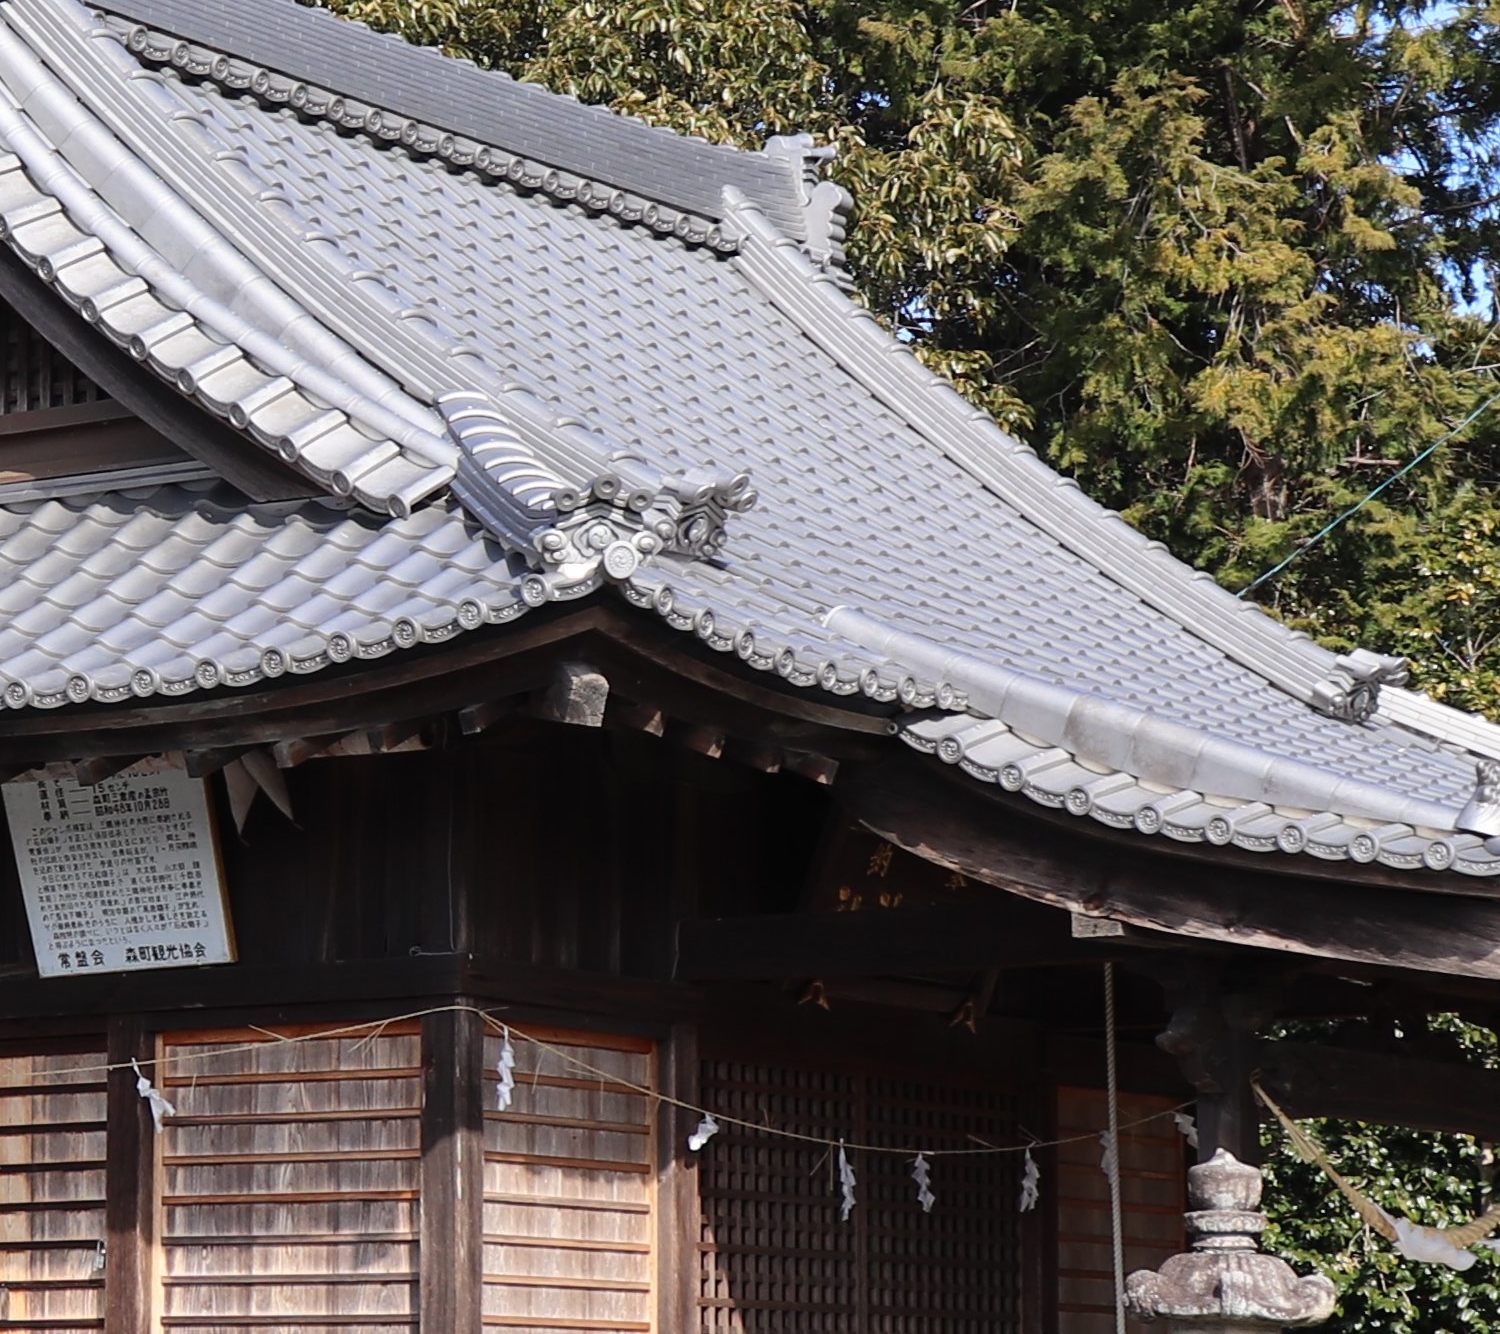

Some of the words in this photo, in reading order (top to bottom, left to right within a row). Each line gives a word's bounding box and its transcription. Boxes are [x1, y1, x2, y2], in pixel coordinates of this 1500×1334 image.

[56, 948, 106, 969] 常盤会
[122, 941, 207, 964] 森町観光協会
